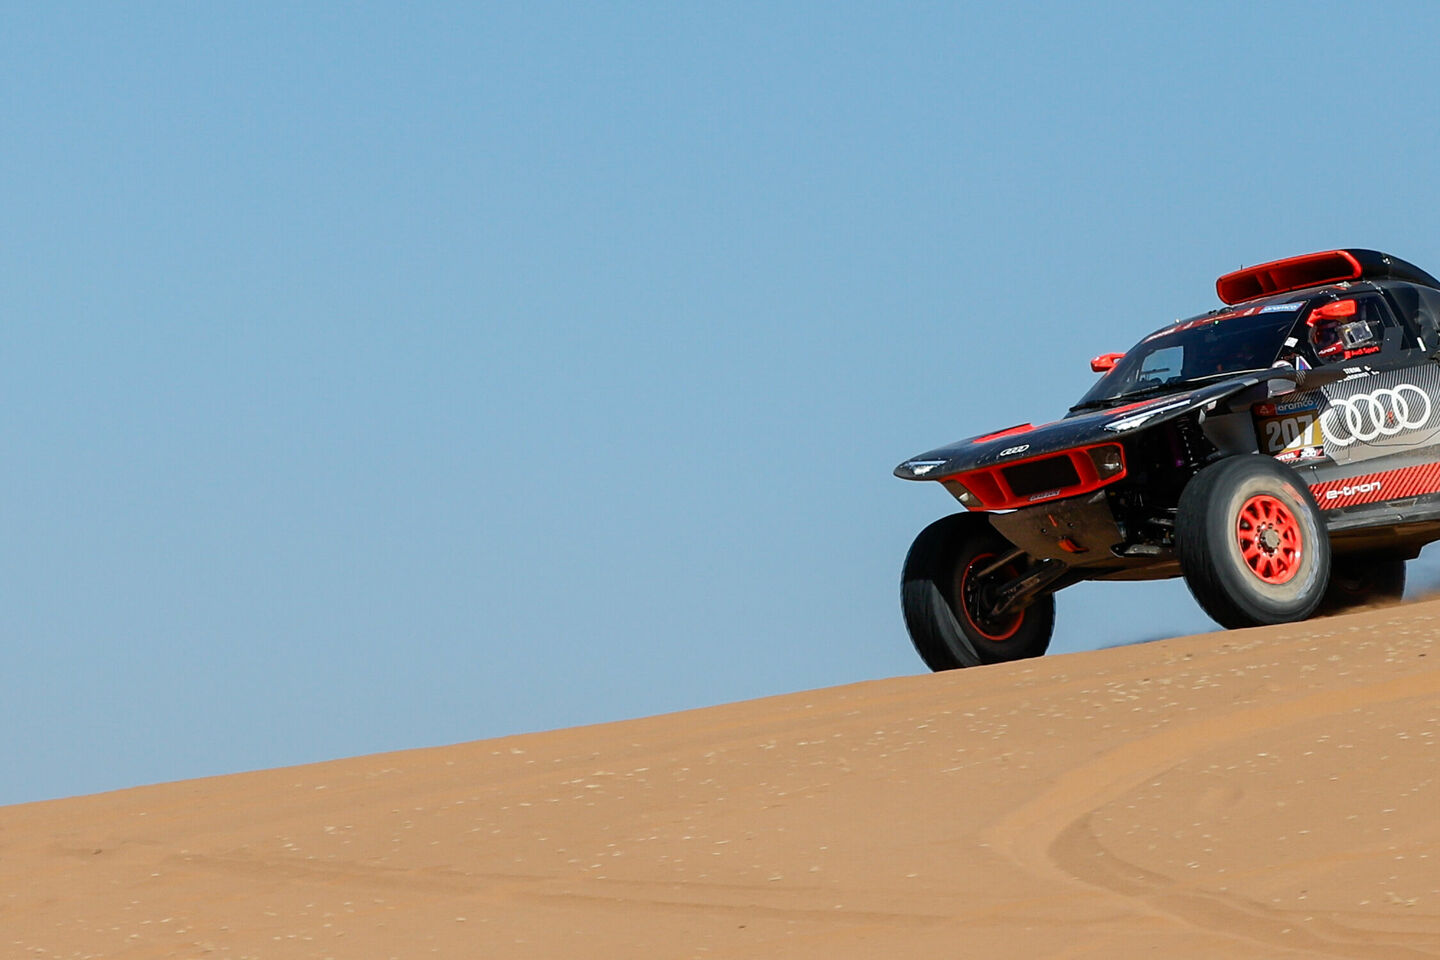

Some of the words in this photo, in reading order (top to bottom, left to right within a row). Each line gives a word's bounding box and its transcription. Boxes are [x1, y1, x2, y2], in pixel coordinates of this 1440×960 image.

[1277, 400, 1314, 411] aramco
[1265, 414, 1314, 452] 207
[1326, 481, 1382, 500] e-tron
